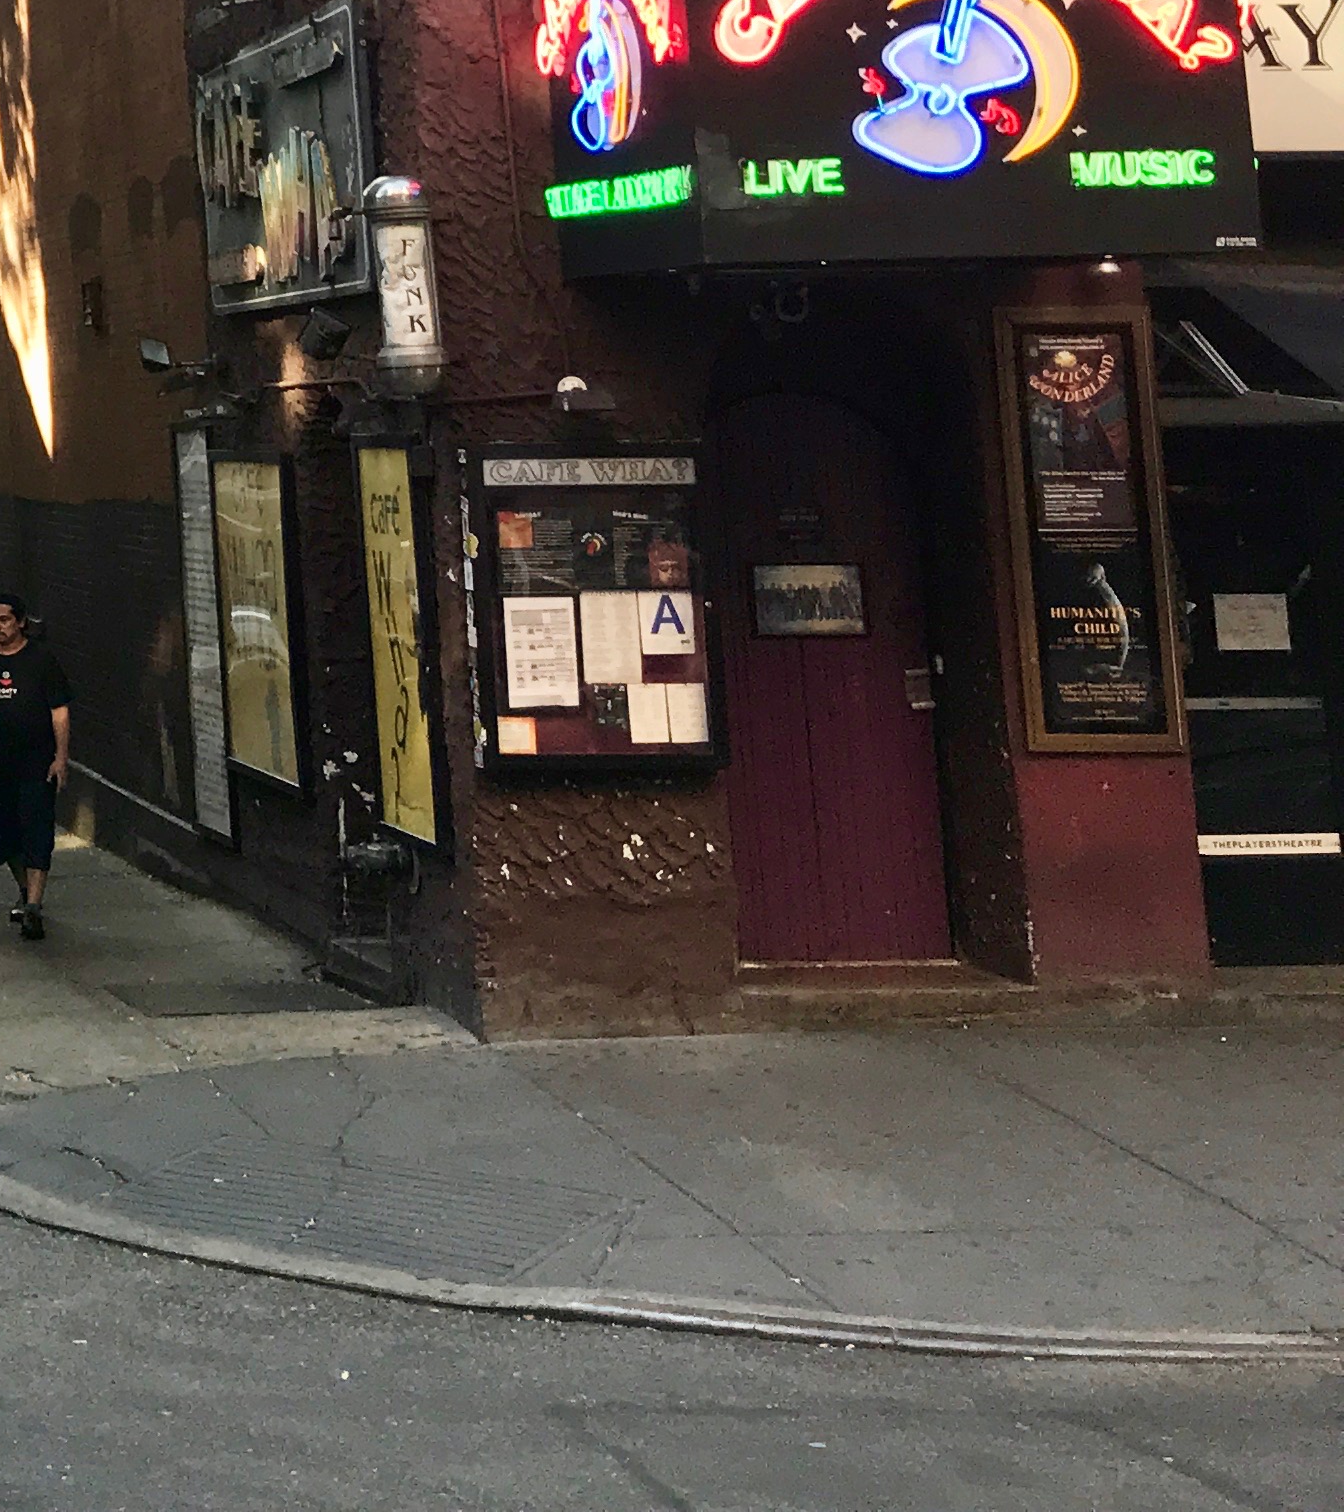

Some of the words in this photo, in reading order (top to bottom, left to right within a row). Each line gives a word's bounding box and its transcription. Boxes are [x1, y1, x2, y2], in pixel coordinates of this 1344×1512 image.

[742, 157, 845, 195] LIVE
[1069, 149, 1216, 187] MUSIC
[489, 460, 581, 483] CAFE
[587, 458, 689, 483] WHA?
[651, 594, 686, 635] A
[1074, 622, 1120, 634] CHILD
